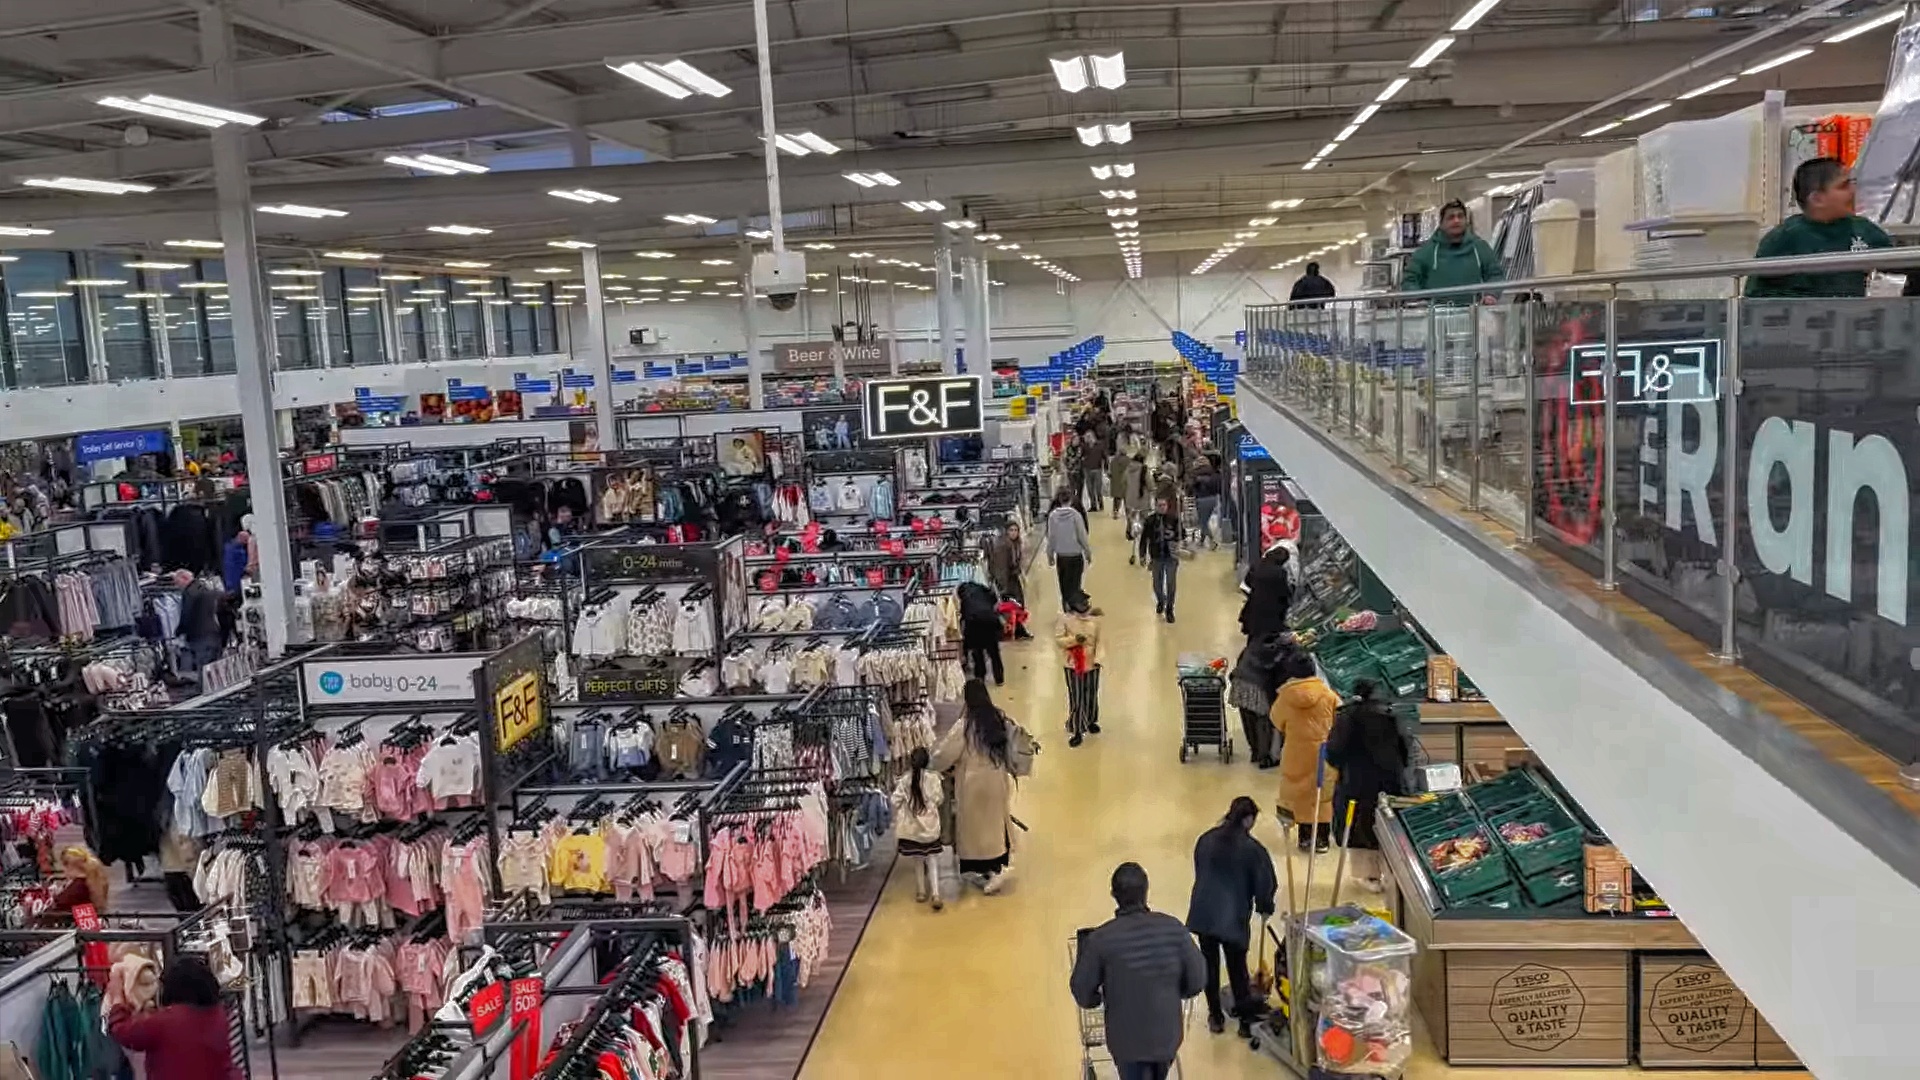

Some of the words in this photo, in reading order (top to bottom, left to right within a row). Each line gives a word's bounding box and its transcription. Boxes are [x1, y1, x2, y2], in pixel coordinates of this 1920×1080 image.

[789, 348, 825, 363] Beer
[843, 346, 881, 360] Wine
[1219, 361, 1231, 371] 22
[877, 382, 971, 432] F&F
[114, 440, 135, 449] Service
[1240, 435, 1254, 445] 23
[622, 554, 657, 569] 0-24
[350, 673, 393, 692] baby
[397, 675, 438, 692] 0-24
[585, 680, 630, 692] PERFECT
[634, 678, 668, 691] GIFTS
[500, 681, 537, 740] F&F
[1513, 972, 1550, 984] TESCO
[1674, 972, 1711, 985] TESCO
[515, 981, 536, 994] SALE
[477, 996, 501, 1017] SALE
[1507, 1004, 1568, 1023] QUALITY
[1668, 1004, 1729, 1024] QUALITY
[1516, 1024, 1525, 1035] &
[1527, 1018, 1567, 1034] TASTE
[1676, 1025, 1685, 1036] &
[1687, 1018, 1727, 1034] TASTE
